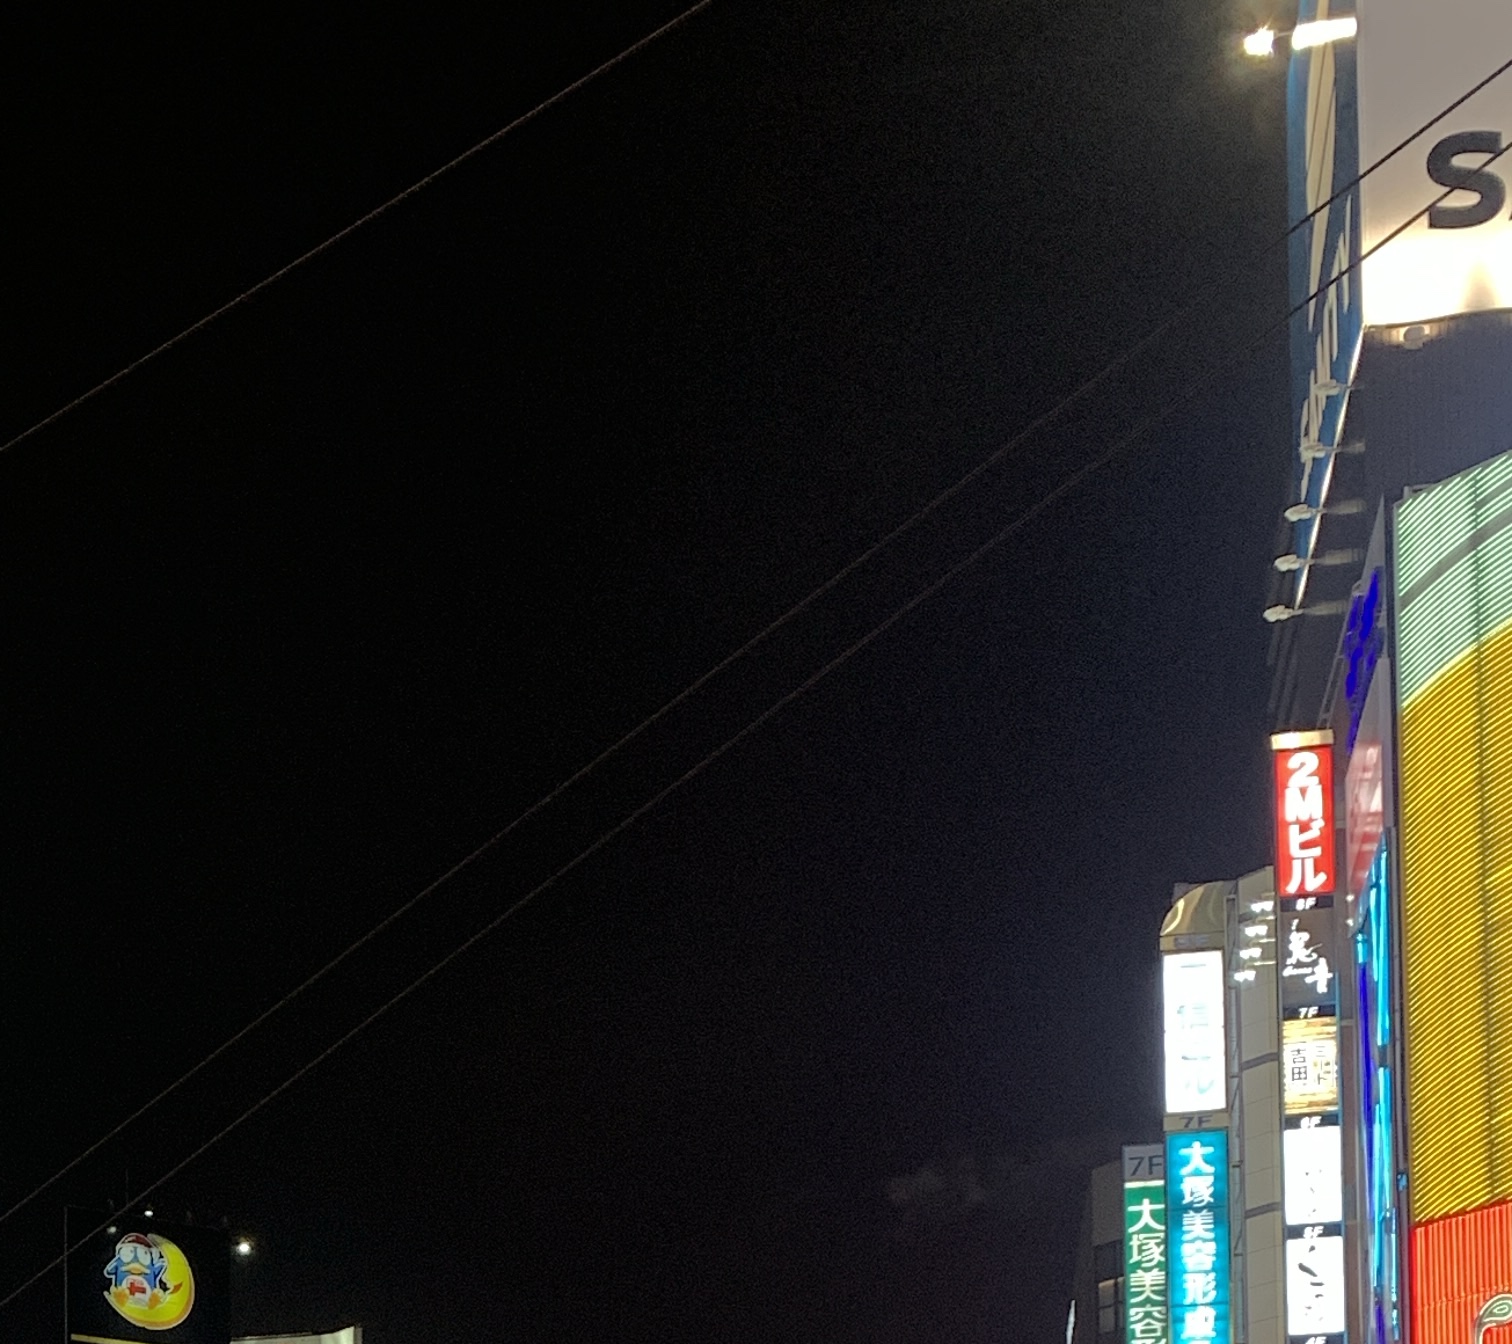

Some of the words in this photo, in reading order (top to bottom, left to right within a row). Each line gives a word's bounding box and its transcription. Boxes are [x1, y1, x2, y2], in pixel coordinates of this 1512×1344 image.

[1427, 131, 1512, 229] S
[1285, 751, 1327, 893] 2Mビル
[1299, 1006, 1318, 1019] 7F
[1179, 1115, 1214, 1129] 7F
[1128, 1156, 1163, 1177] 7F
